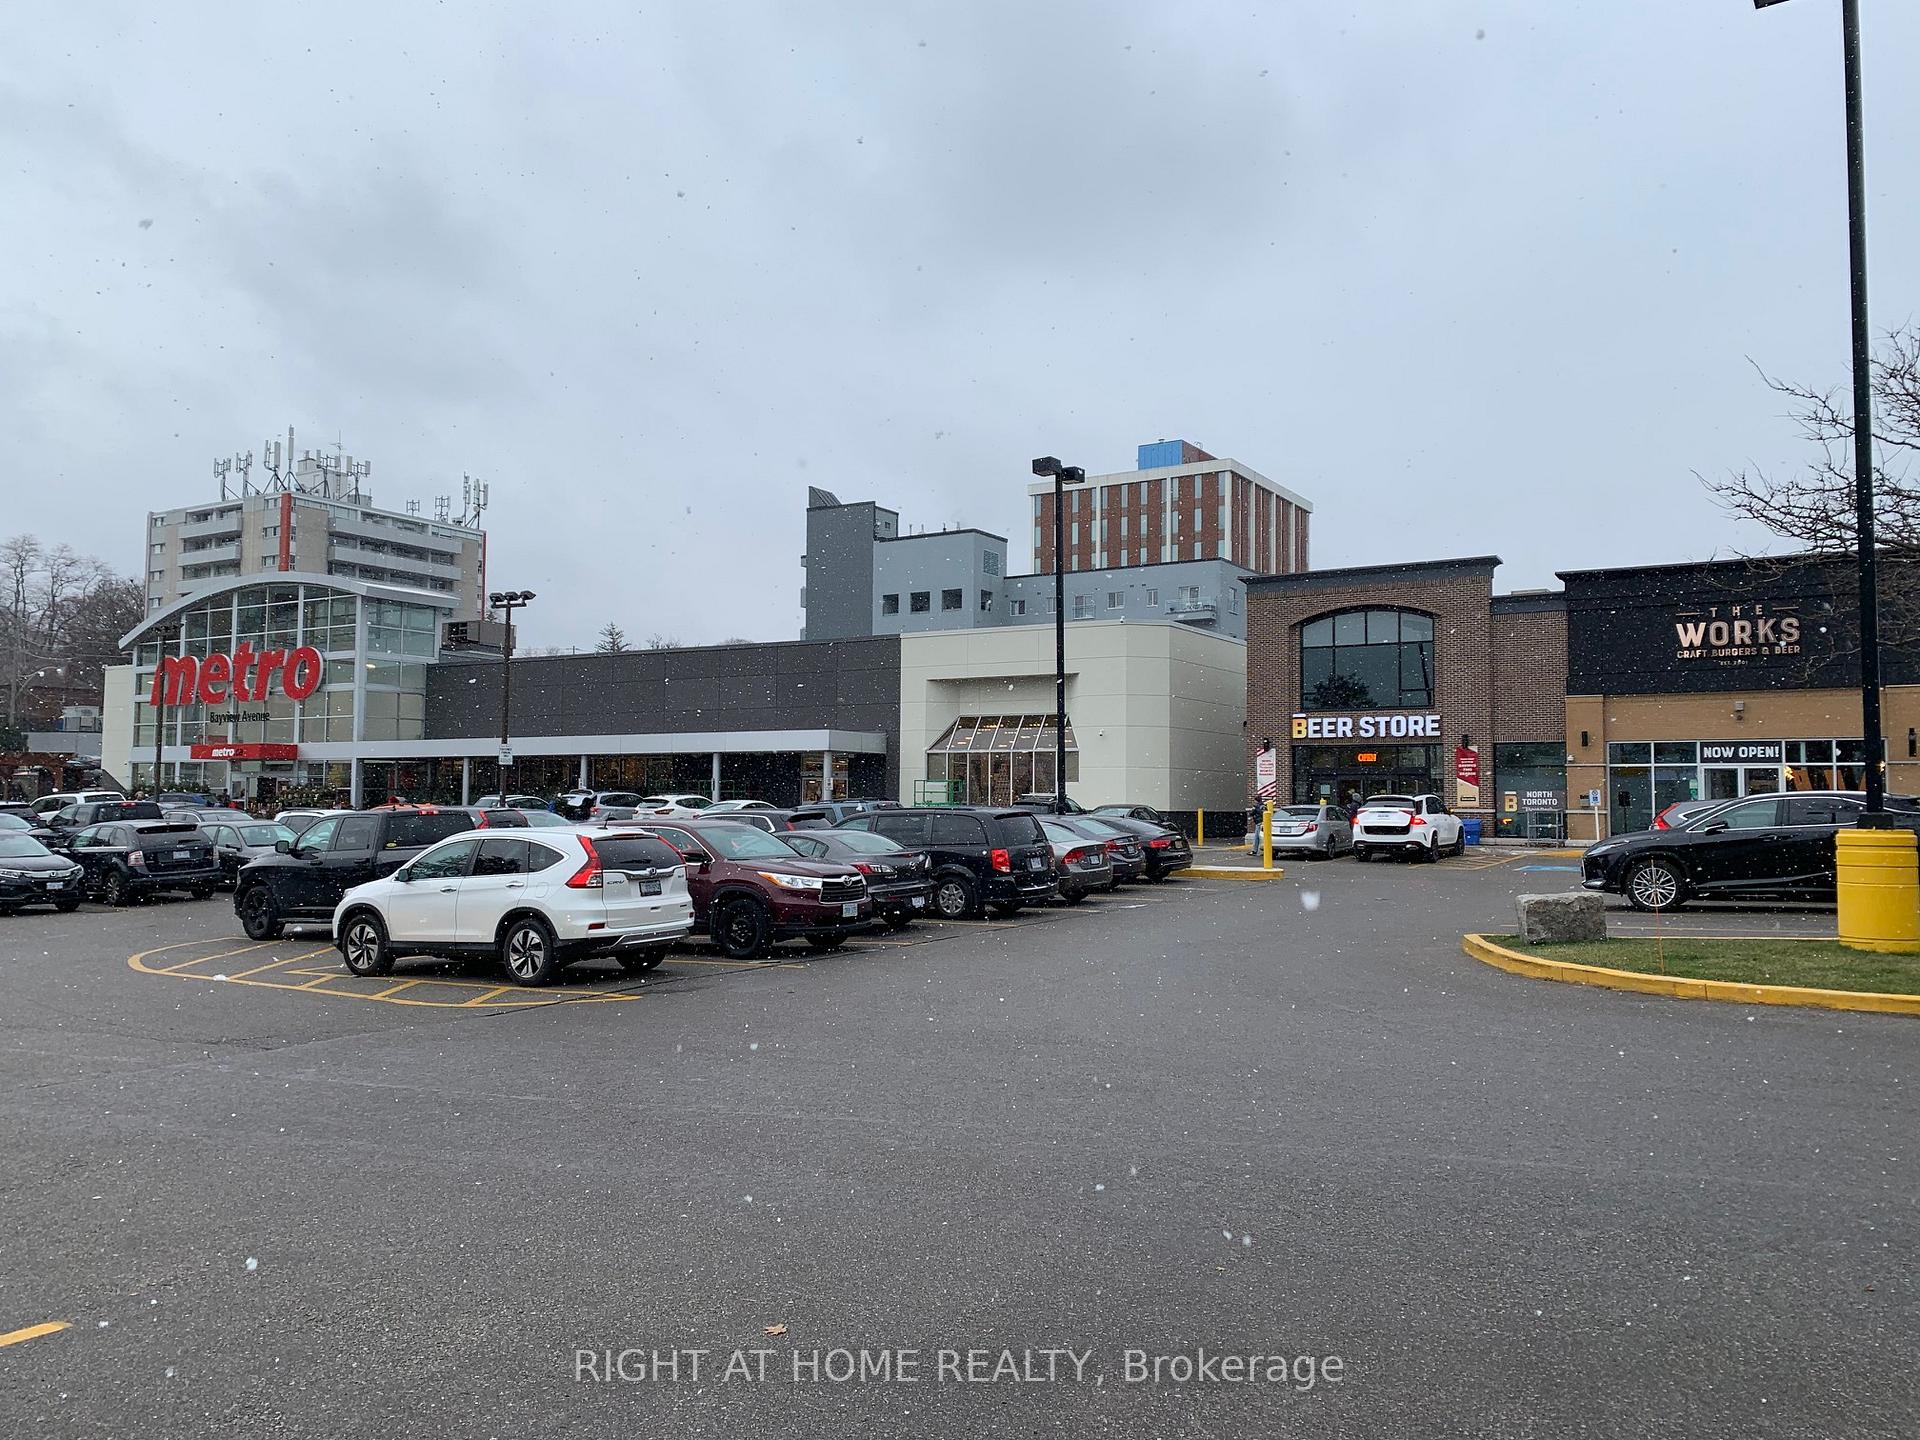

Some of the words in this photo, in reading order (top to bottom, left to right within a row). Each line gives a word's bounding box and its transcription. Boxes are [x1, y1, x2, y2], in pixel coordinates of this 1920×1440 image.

[1709, 604, 1763, 618] THE
[1676, 617, 1800, 648] WORKS
[1676, 649, 1708, 659] CRAFT
[1711, 647, 1758, 658] BURGERS
[1761, 646, 1770, 655] &
[1774, 645, 1800, 654] BEER
[150, 640, 323, 706] metro
[209, 711, 240, 725] Bayview
[241, 710, 270, 721] Avenue
[1292, 713, 1353, 739] BEER
[1359, 715, 1441, 738] STORE
[1357, 753, 1377, 762] OPEN
[1703, 746, 1735, 758] NOW
[1738, 746, 1780, 758] OPEN!
[1521, 798, 1558, 806] TORONTO
